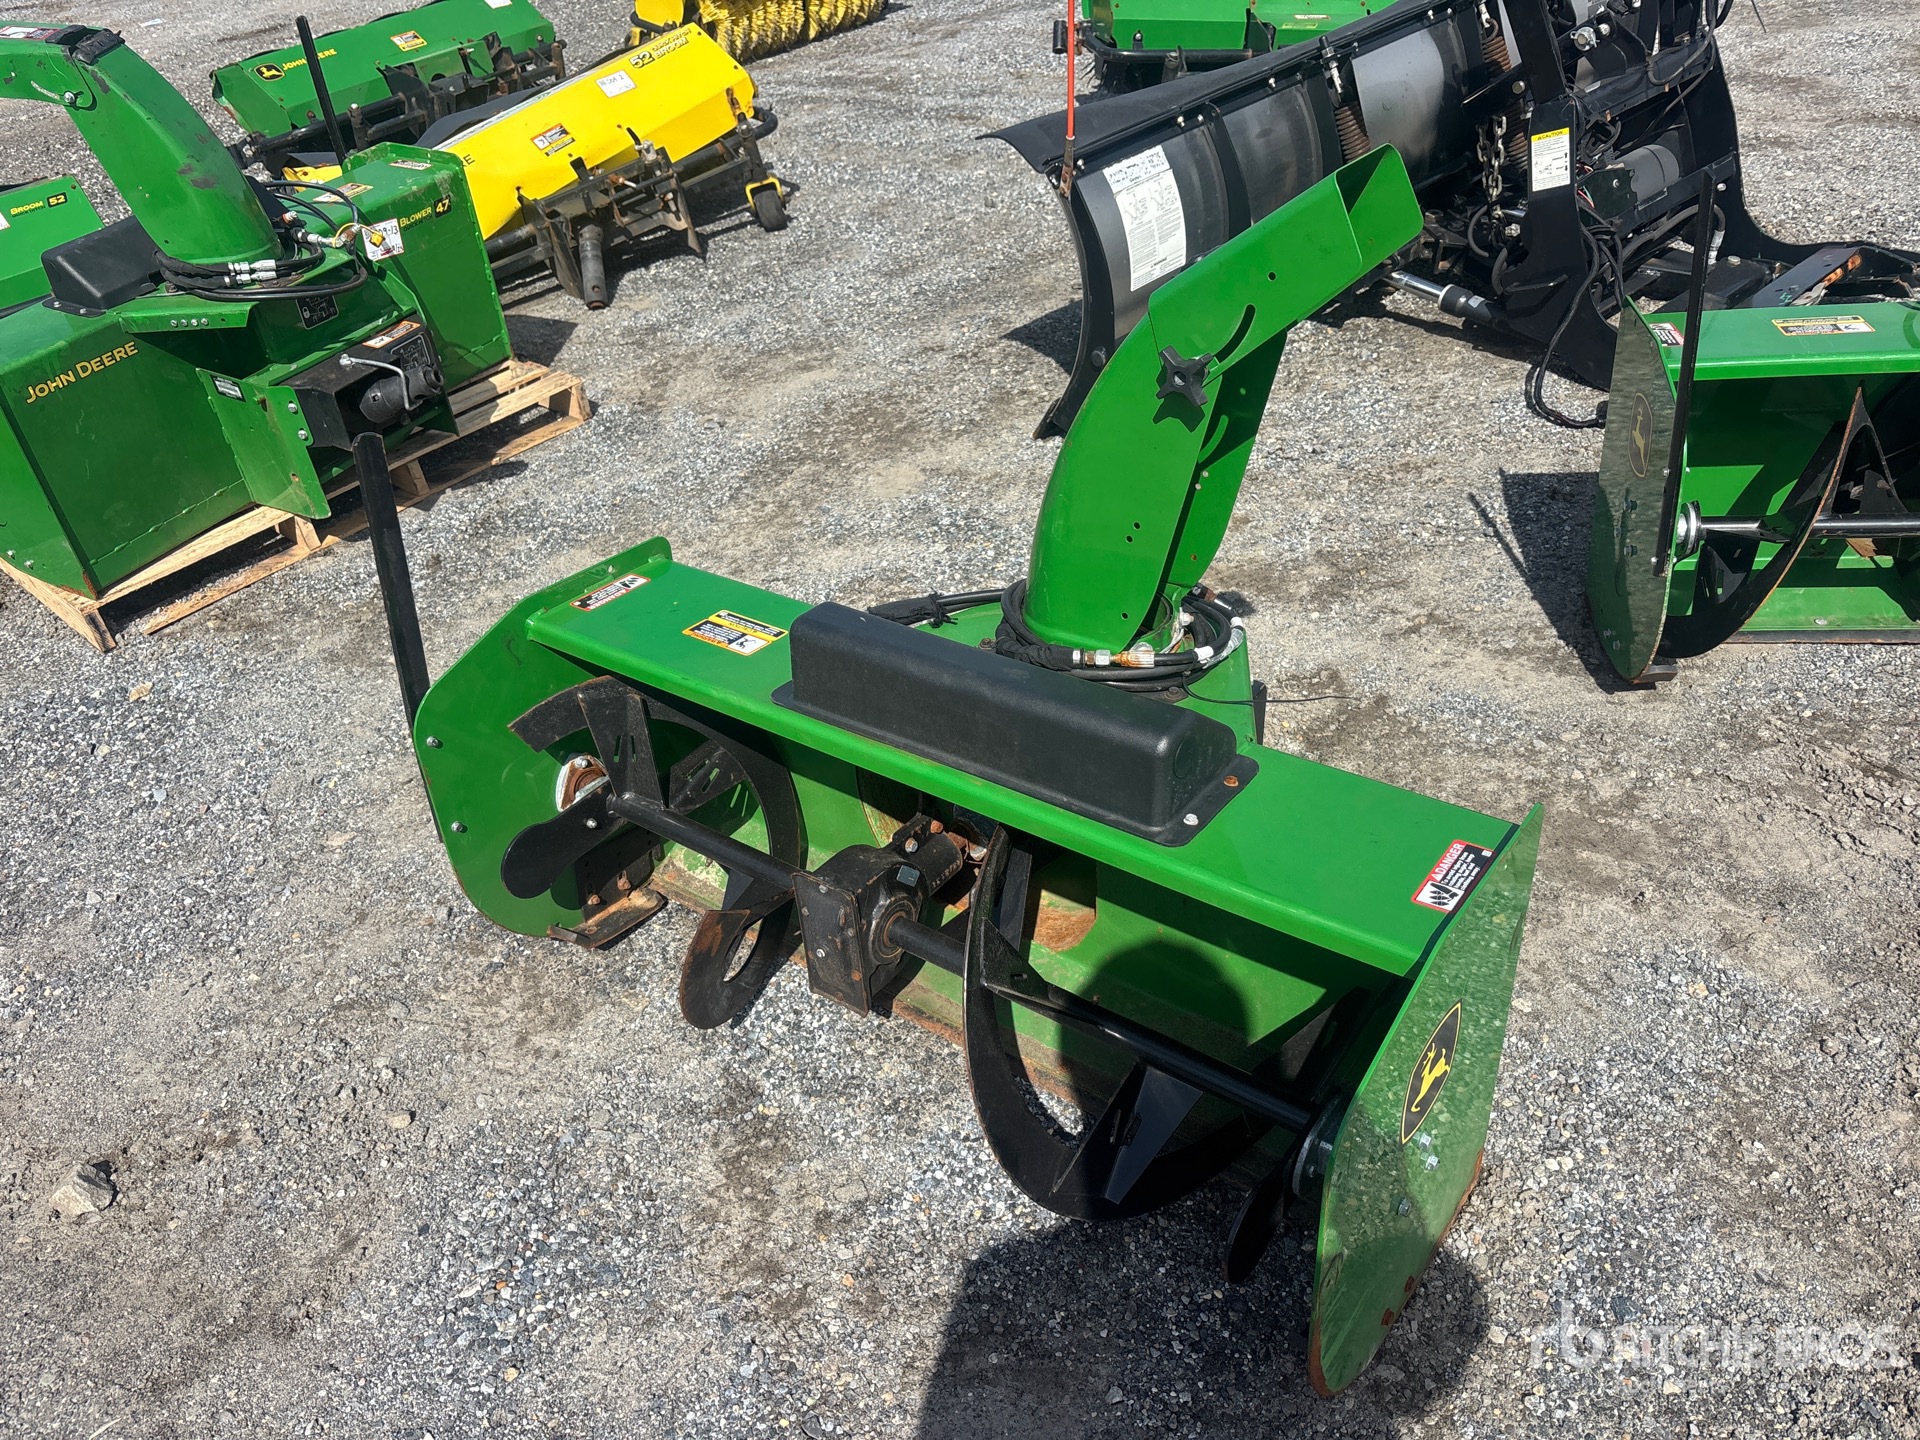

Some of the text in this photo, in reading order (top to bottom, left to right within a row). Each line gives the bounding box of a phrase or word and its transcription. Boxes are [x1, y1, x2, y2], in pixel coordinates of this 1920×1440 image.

[282, 48, 338, 71] JOHN ERE
[629, 51, 655, 68] 52
[654, 37, 689, 59] BROOM
[10, 194, 66, 215] BROOM 52
[399, 199, 450, 227] BLOWER 47
[26, 341, 139, 404] JOHN DEERE
[1435, 843, 1465, 878] DANGER
